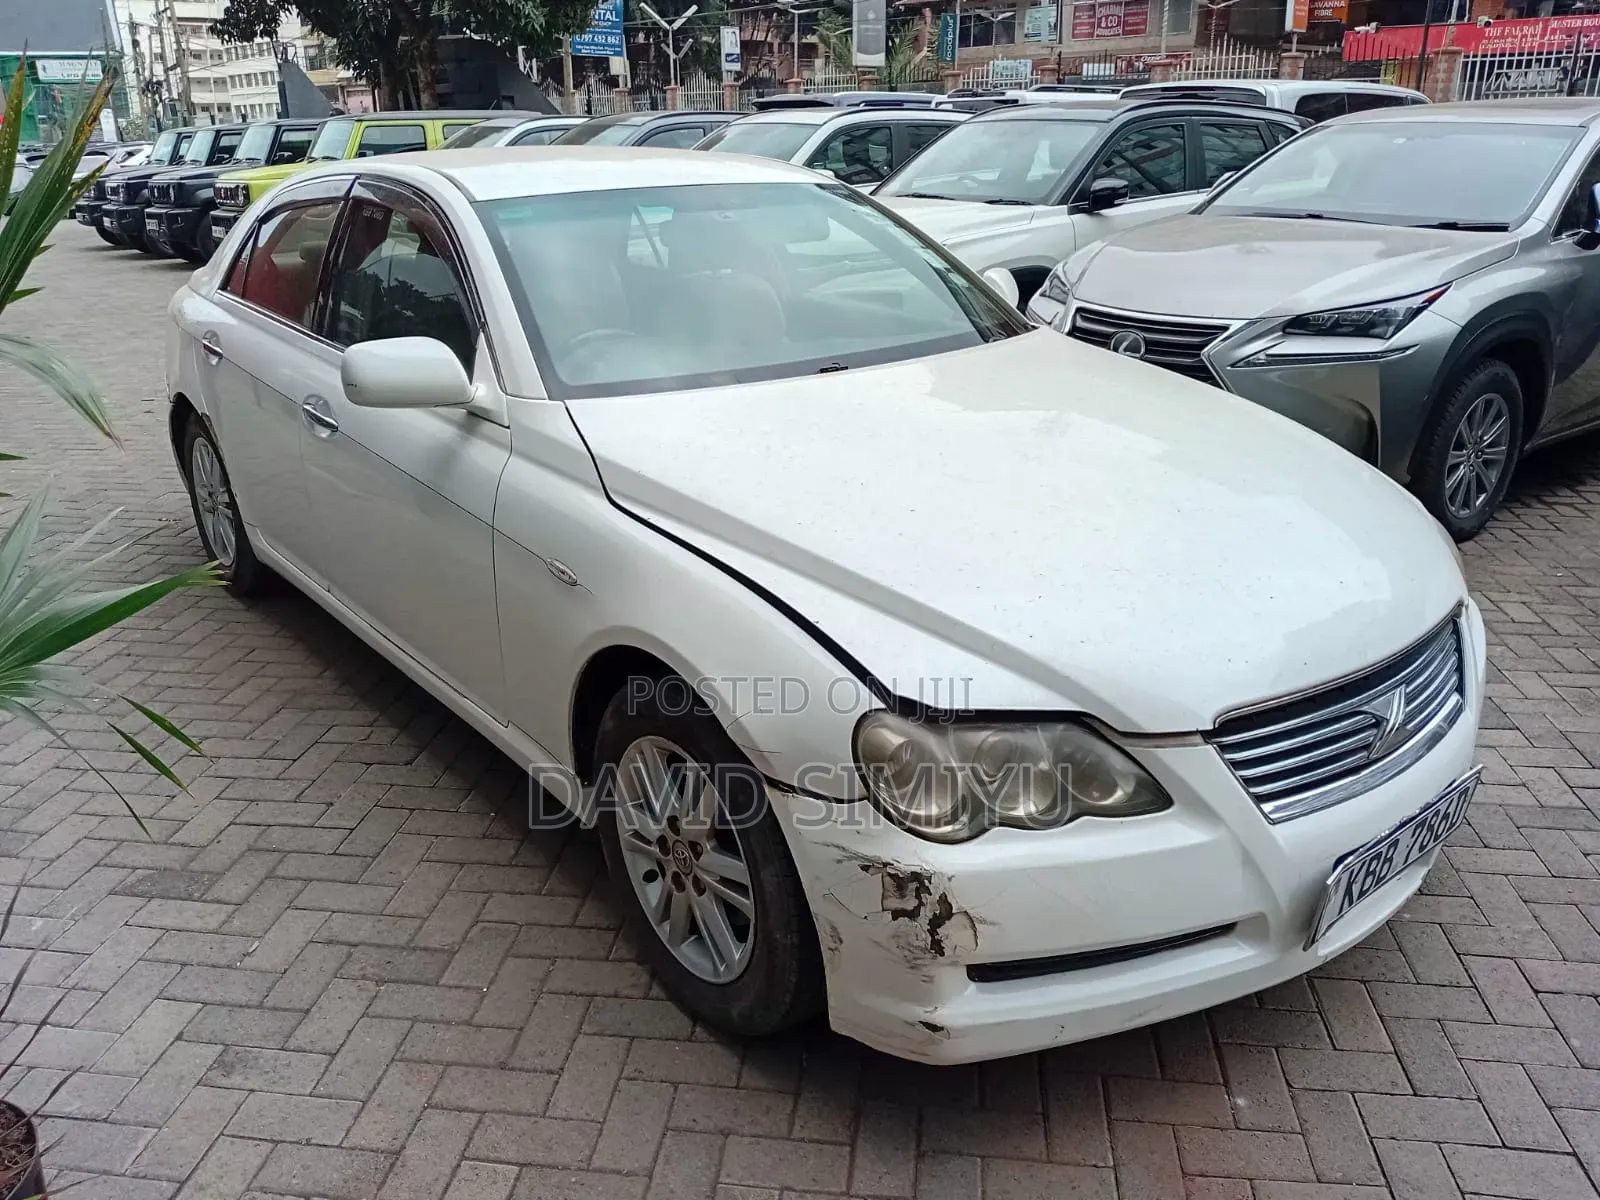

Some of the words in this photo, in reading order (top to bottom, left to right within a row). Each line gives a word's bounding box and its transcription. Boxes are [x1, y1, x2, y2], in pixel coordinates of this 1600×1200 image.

[1107, 16, 1118, 27] CO
[1550, 18, 1582, 28] MASTER
[946, 17, 954, 60] foodplus
[1338, 837, 1401, 917] KBB
